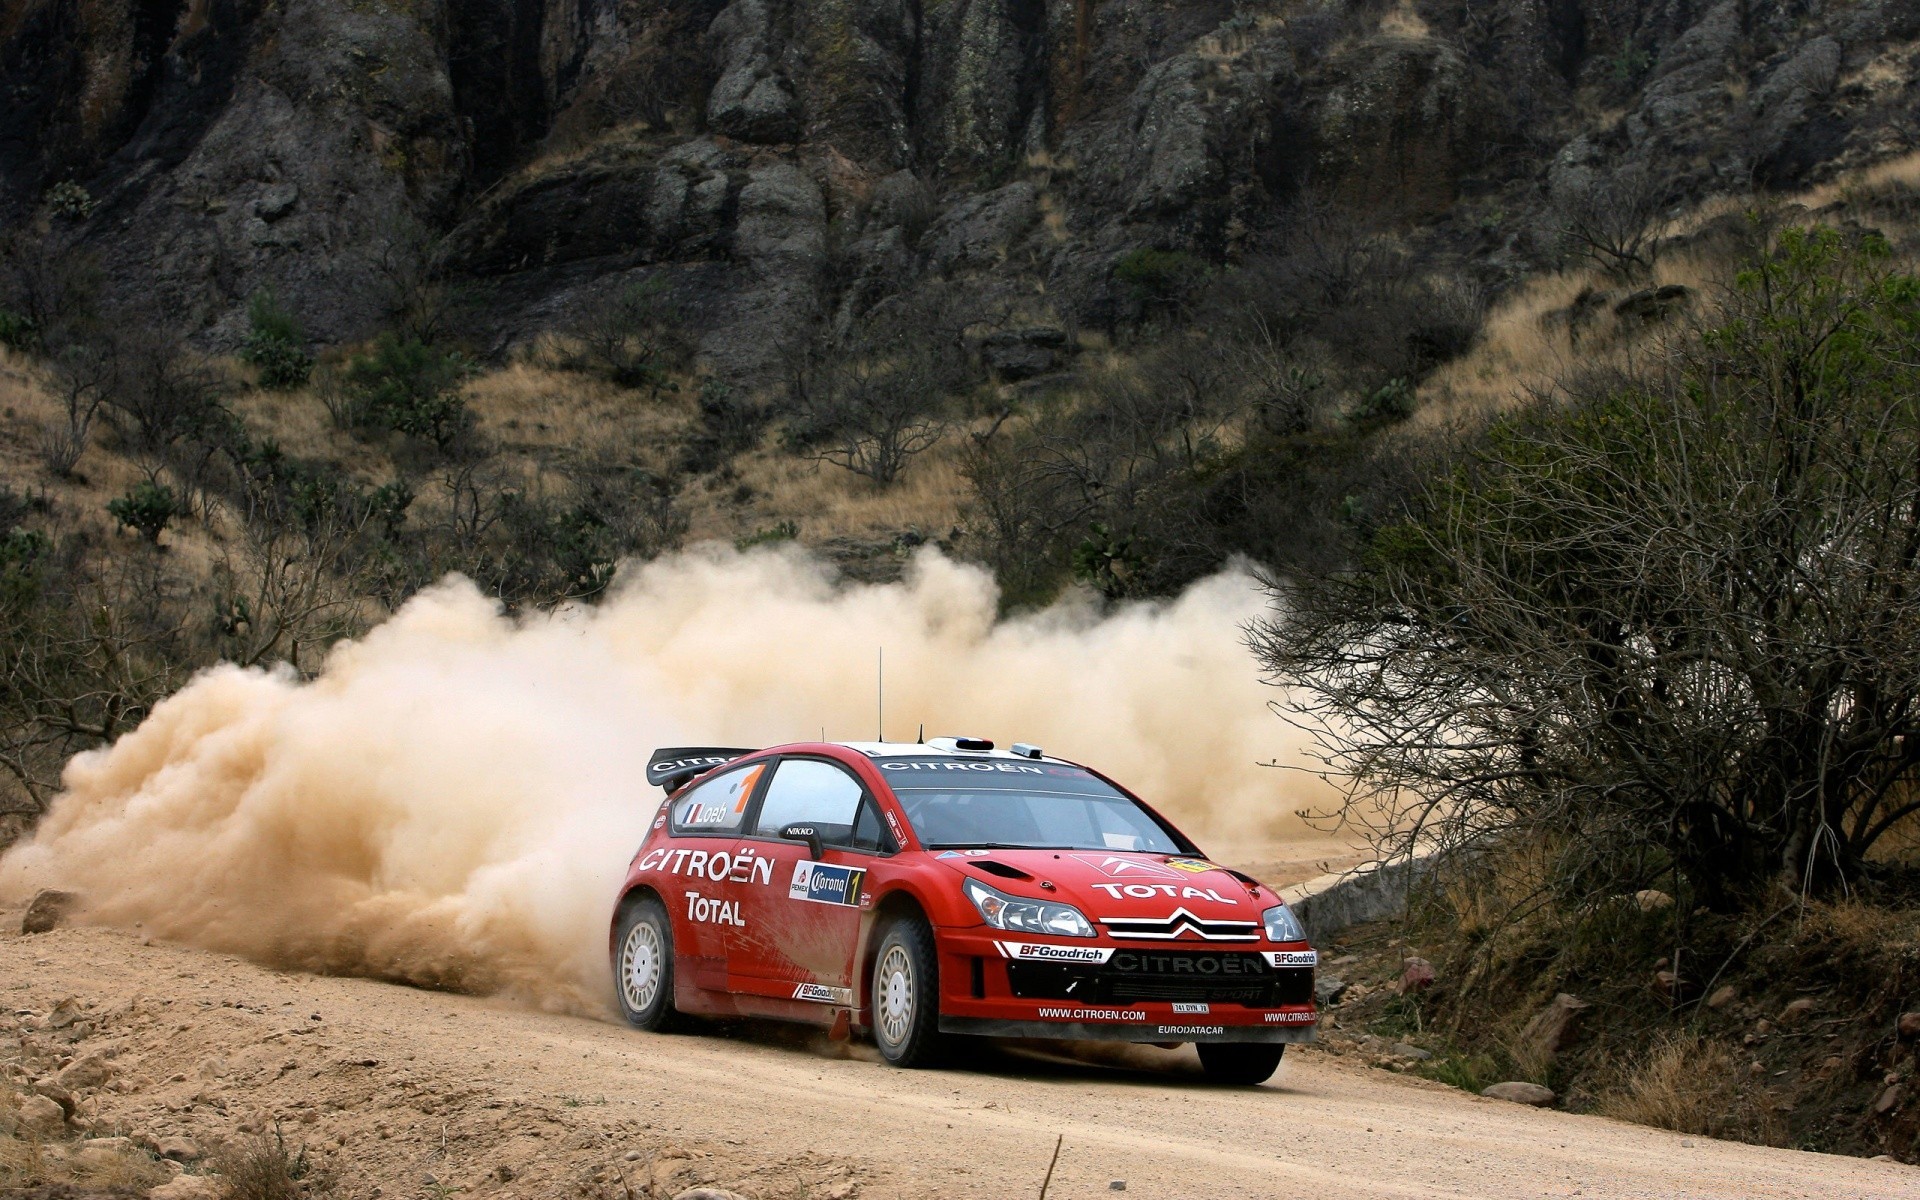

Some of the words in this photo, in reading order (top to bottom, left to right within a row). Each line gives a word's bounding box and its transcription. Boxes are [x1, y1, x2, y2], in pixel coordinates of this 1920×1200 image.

[881, 762, 1043, 775] CITROËN
[735, 764, 766, 813] 1
[696, 804, 727, 823] Loeb
[786, 827, 814, 835] NIKKO
[639, 848, 775, 885] CITROËN
[811, 871, 845, 894] Corona
[852, 872, 860, 904] 1
[1091, 883, 1238, 904] TOTAL
[685, 891, 745, 927] TOTAL
[1020, 944, 1103, 959] BFGoodrich
[1112, 953, 1263, 974] CITROËN
[1039, 1007, 1146, 1021] WWW.CITROEN.COM
[1158, 1025, 1224, 1035] EURODATACAR
